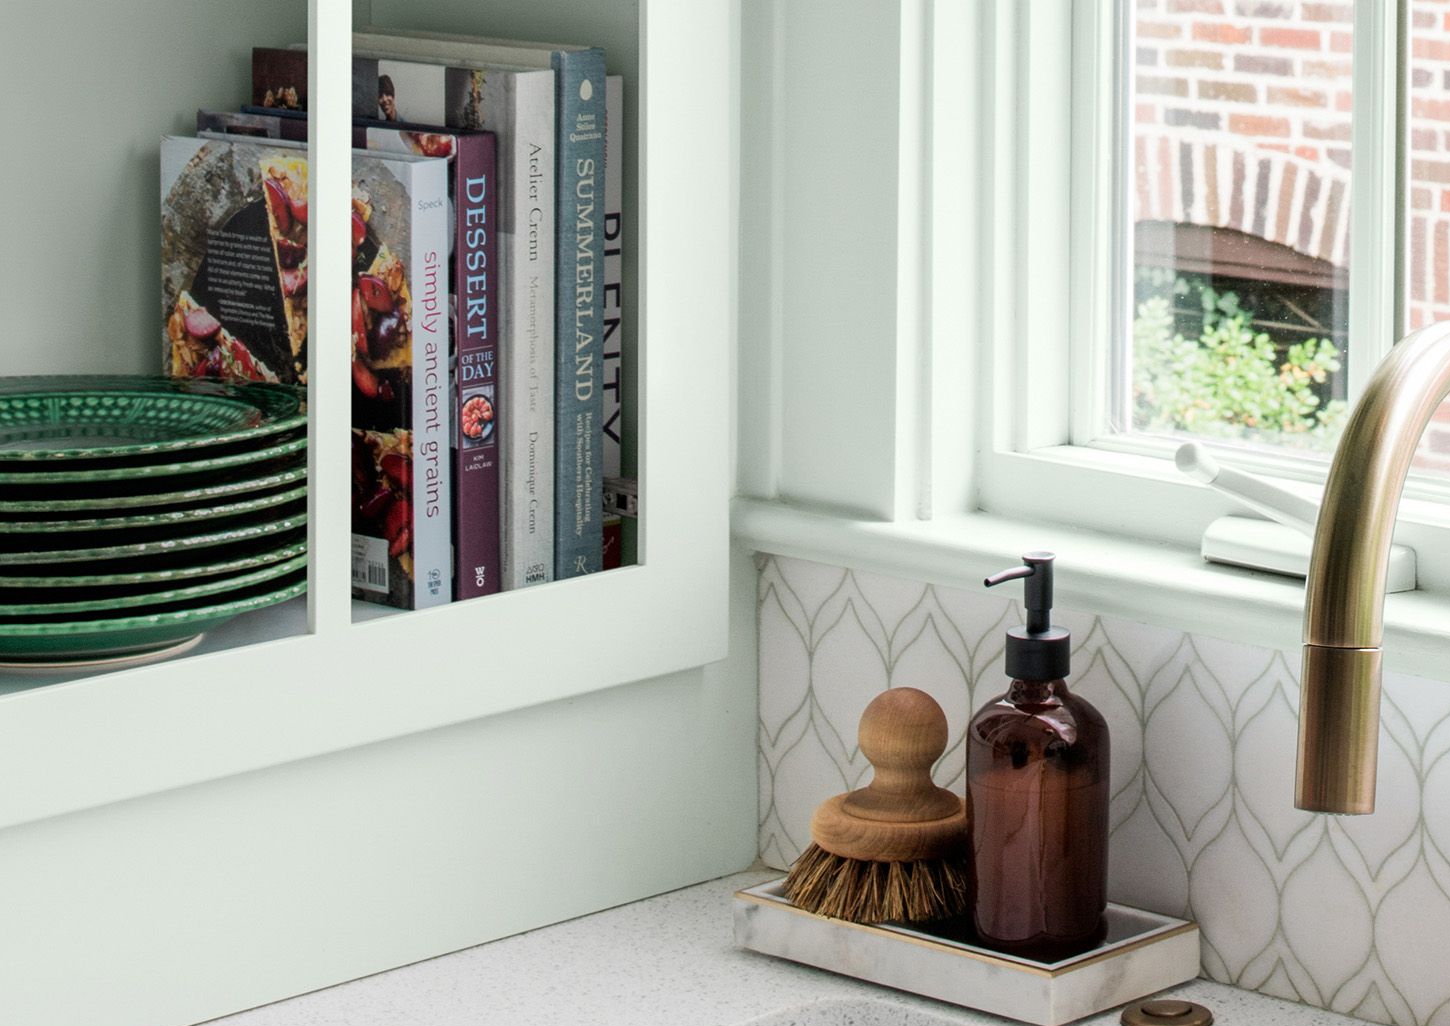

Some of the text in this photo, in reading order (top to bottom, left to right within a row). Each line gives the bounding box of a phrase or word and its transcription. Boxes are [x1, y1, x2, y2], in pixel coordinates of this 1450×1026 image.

[418, 197, 443, 213] Speck
[529, 143, 543, 261] Atelier Crenn
[466, 174, 487, 340] DESSERT
[575, 157, 595, 402] SUMMERLAND
[526, 275, 539, 364] Metamorphosis
[420, 251, 443, 519] simply ancient grains
[462, 350, 494, 365] OF THE
[462, 362, 494, 381] DAY
[529, 367, 539, 379] of
[585, 412, 593, 450] Recipes
[526, 431, 539, 535] Dominique Crenn
[575, 413, 584, 537] with Southern Hospitality
[585, 467, 593, 523] Celebrating
[525, 572, 545, 584] HMH
